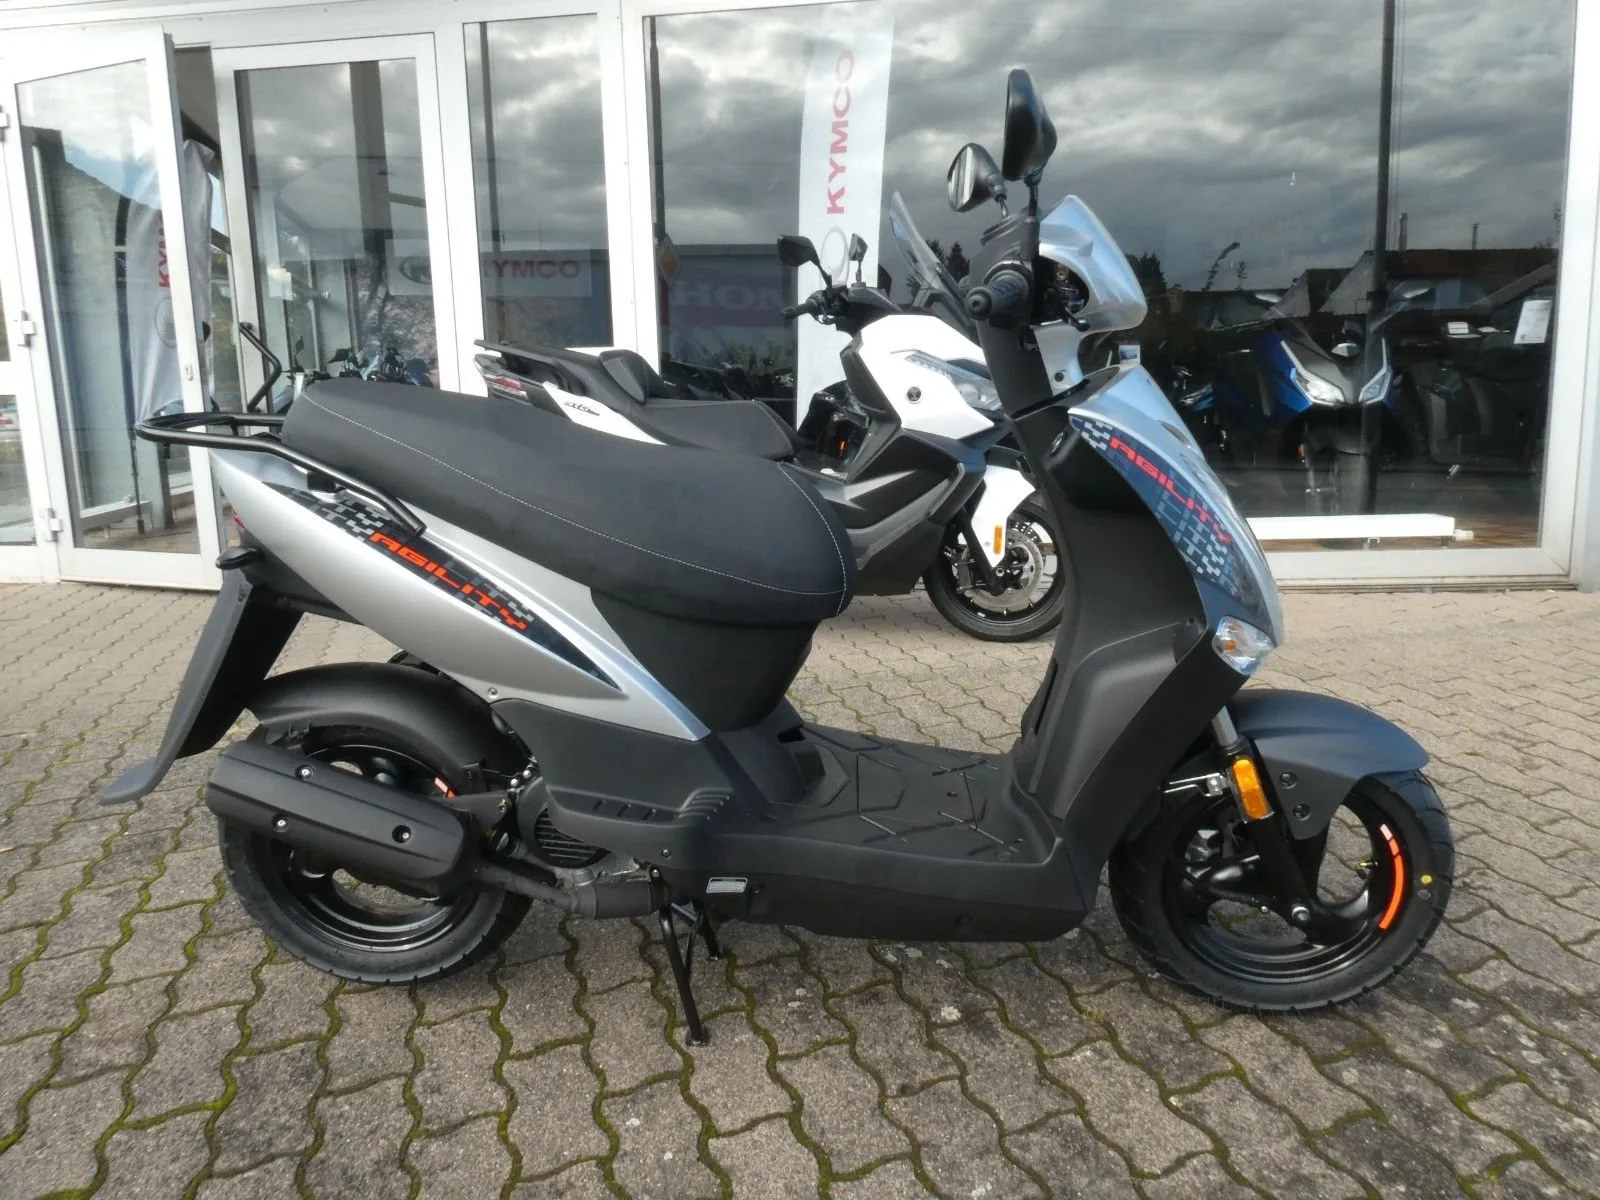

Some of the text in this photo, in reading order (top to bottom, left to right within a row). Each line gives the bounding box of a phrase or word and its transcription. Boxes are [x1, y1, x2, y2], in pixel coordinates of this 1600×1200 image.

[826, 49, 855, 214] KYMCO
[1109, 436, 1232, 544] AGILITY
[369, 531, 527, 631] AGILITY
